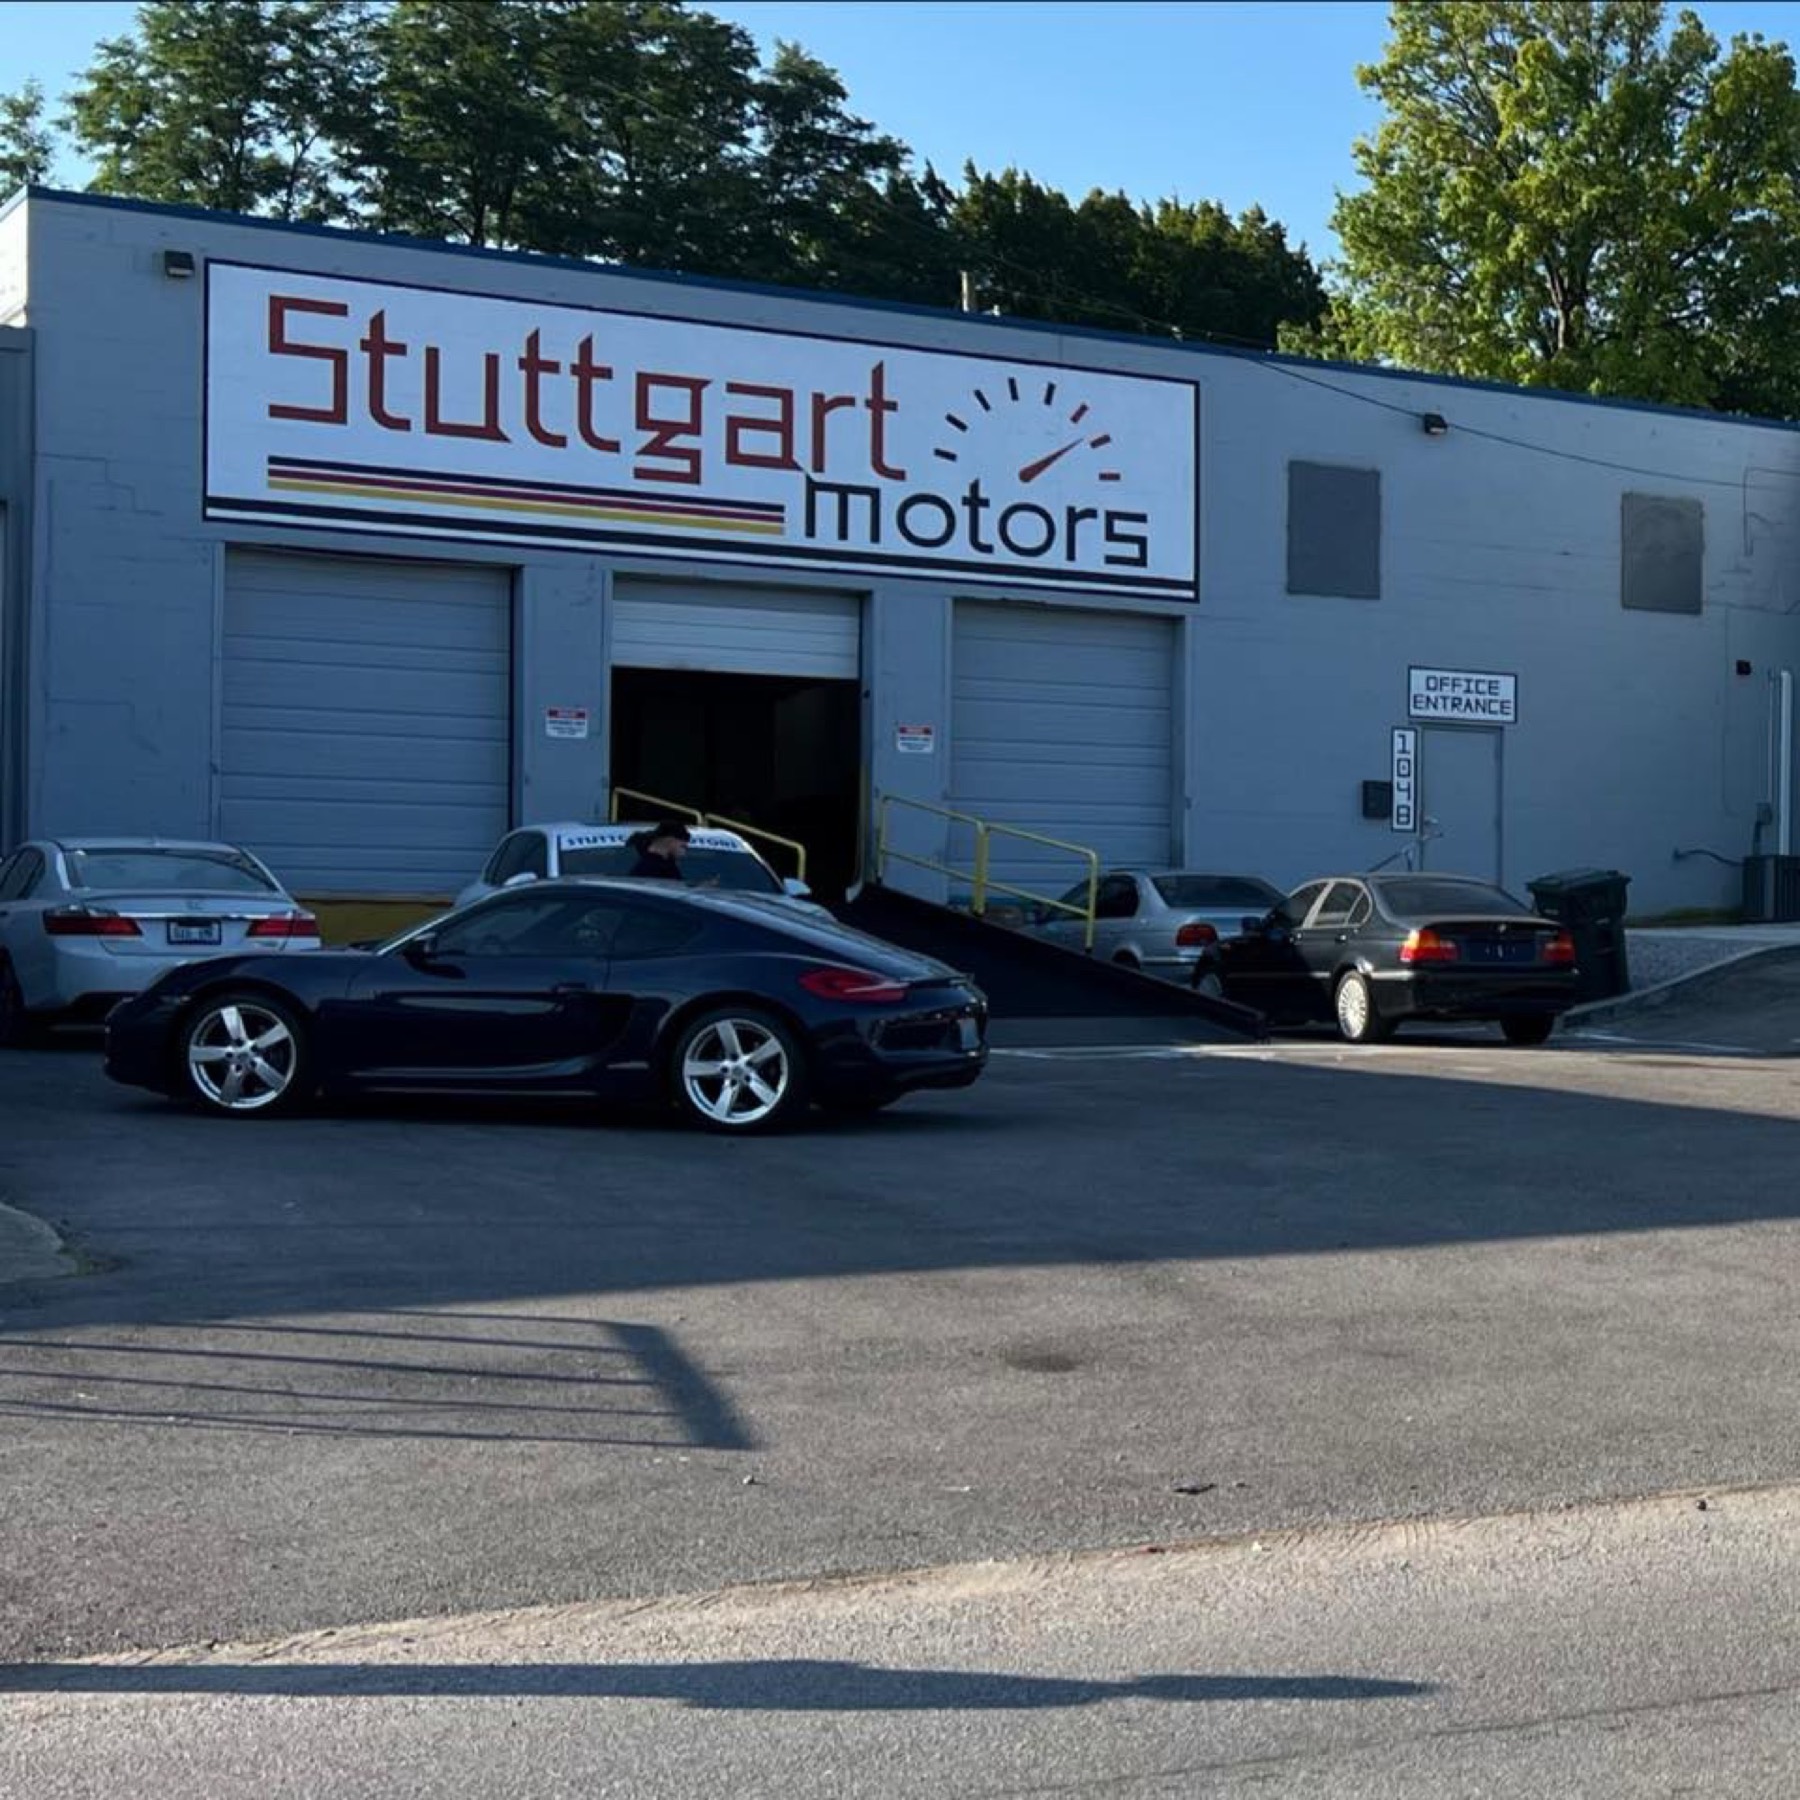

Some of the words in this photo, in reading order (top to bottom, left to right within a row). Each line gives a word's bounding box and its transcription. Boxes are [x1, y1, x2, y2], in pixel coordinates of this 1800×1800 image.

[269, 295, 906, 484] Stuttgart
[804, 473, 1148, 568] motors
[1412, 694, 1512, 716] ENTRANCE
[1425, 675, 1499, 696] OFFICE
[1396, 734, 1411, 826] 1048
